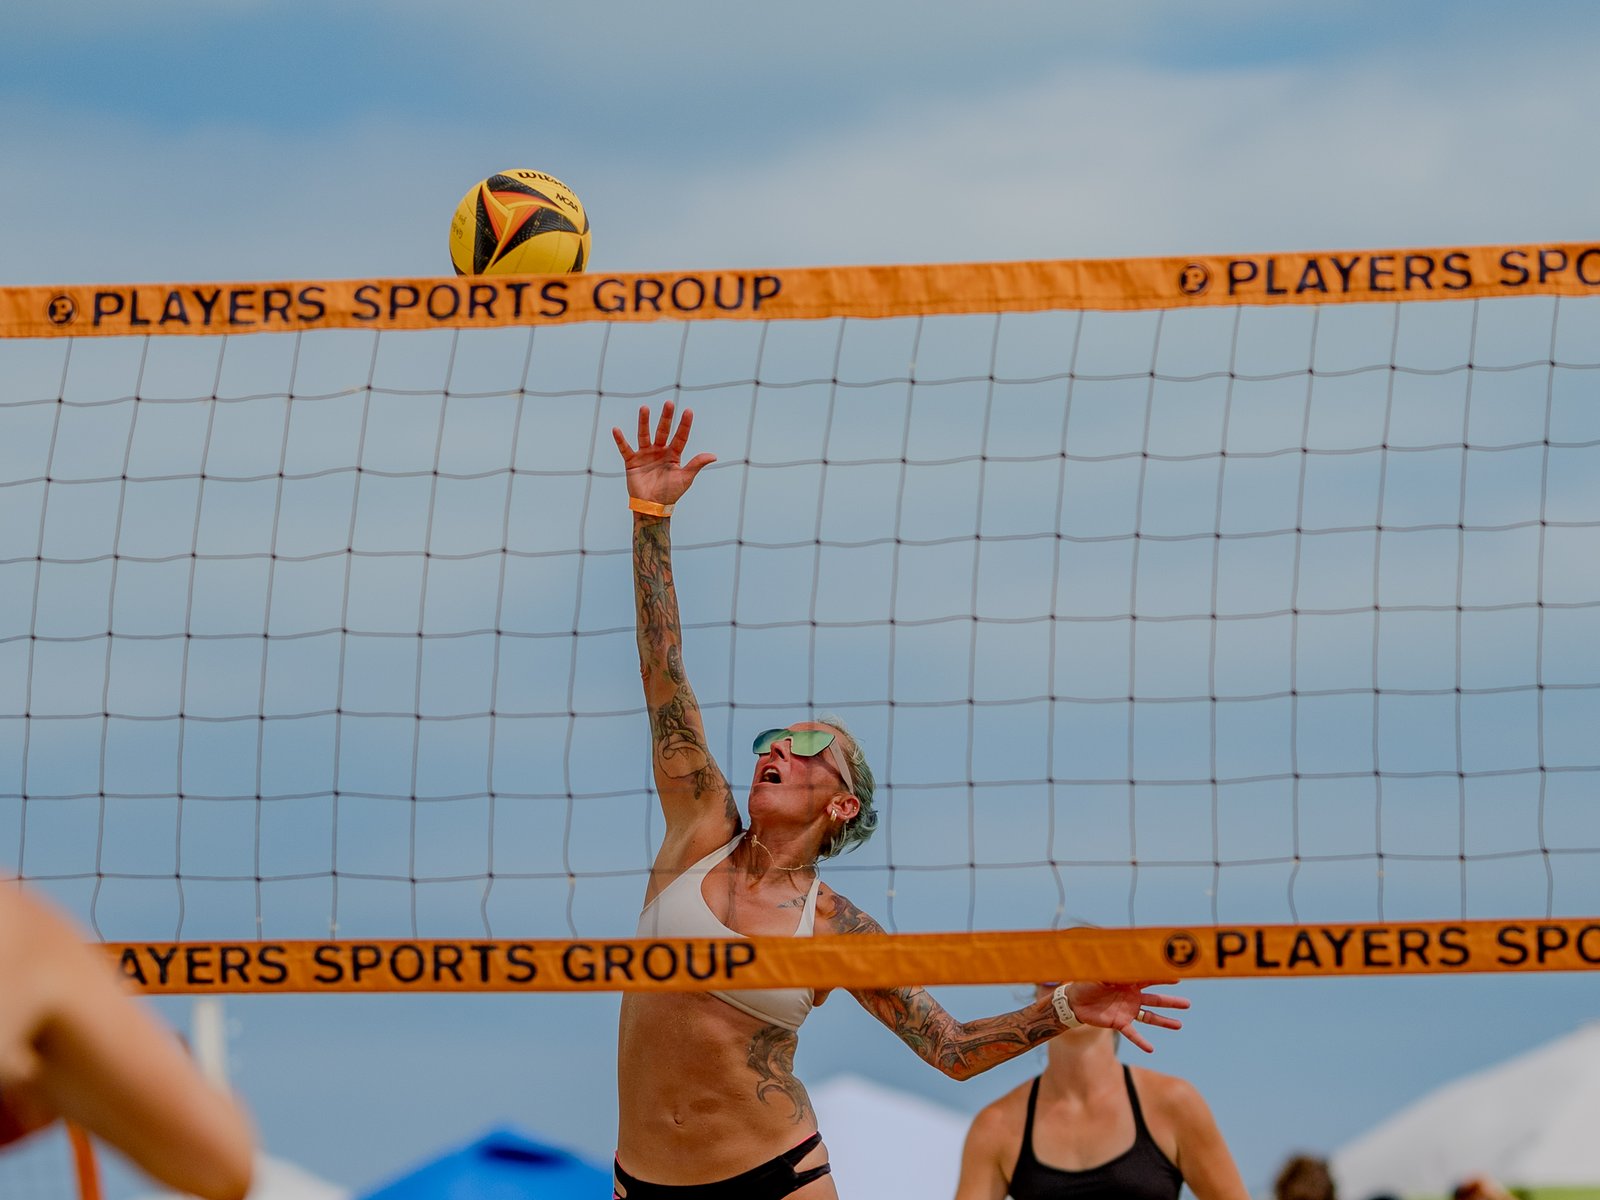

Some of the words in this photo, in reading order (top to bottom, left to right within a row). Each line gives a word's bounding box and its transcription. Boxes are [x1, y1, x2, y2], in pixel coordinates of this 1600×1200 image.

[1228, 252, 1472, 295] PLAYERS
[1500, 248, 1600, 286] SPO
[93, 286, 326, 326] PLAYERS
[352, 281, 568, 320] SPORTS
[592, 275, 781, 313] GROUP
[119, 945, 288, 985] AYERS
[314, 944, 537, 984] SPORTS
[562, 942, 756, 983] GROUP
[1216, 927, 1470, 969] PLAYERS
[1497, 924, 1600, 966] SPO
